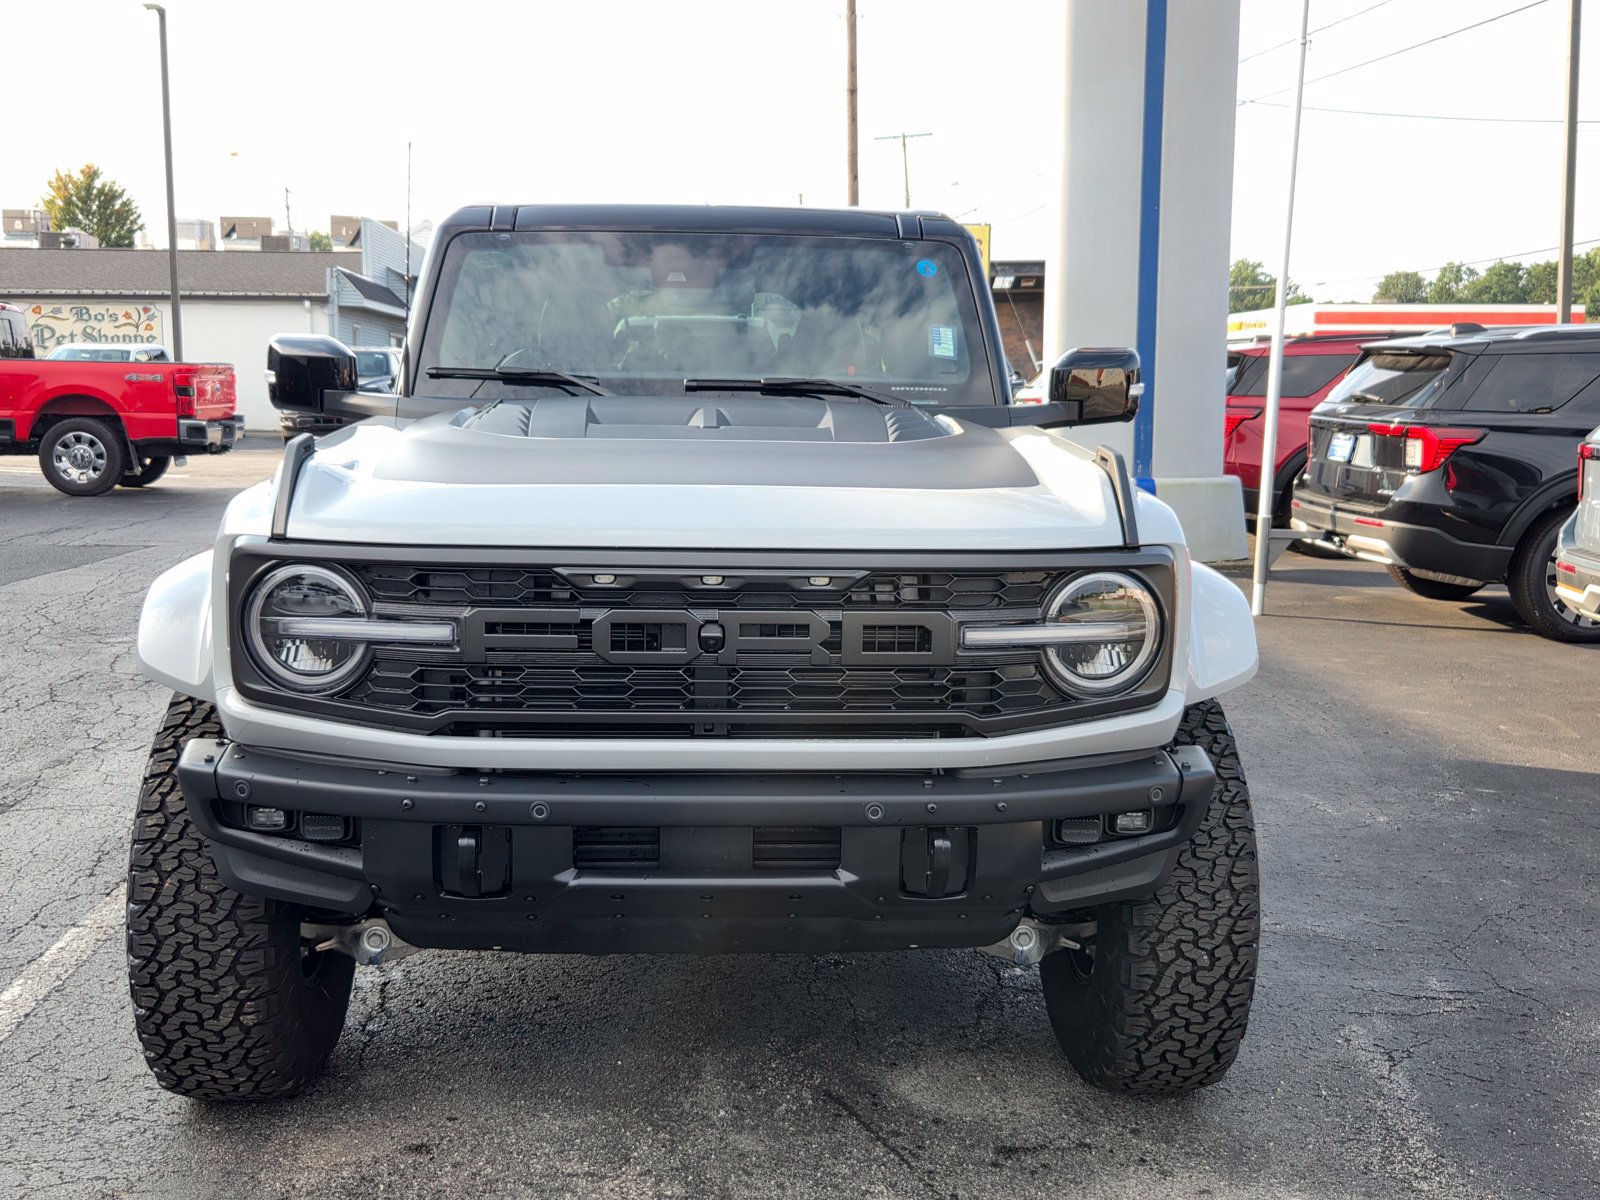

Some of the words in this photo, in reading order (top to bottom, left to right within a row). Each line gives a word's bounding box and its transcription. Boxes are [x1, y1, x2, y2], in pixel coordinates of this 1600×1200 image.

[70, 306, 120, 324] Bo's
[31, 323, 78, 350] Pet
[463, 607, 953, 666] FORD
